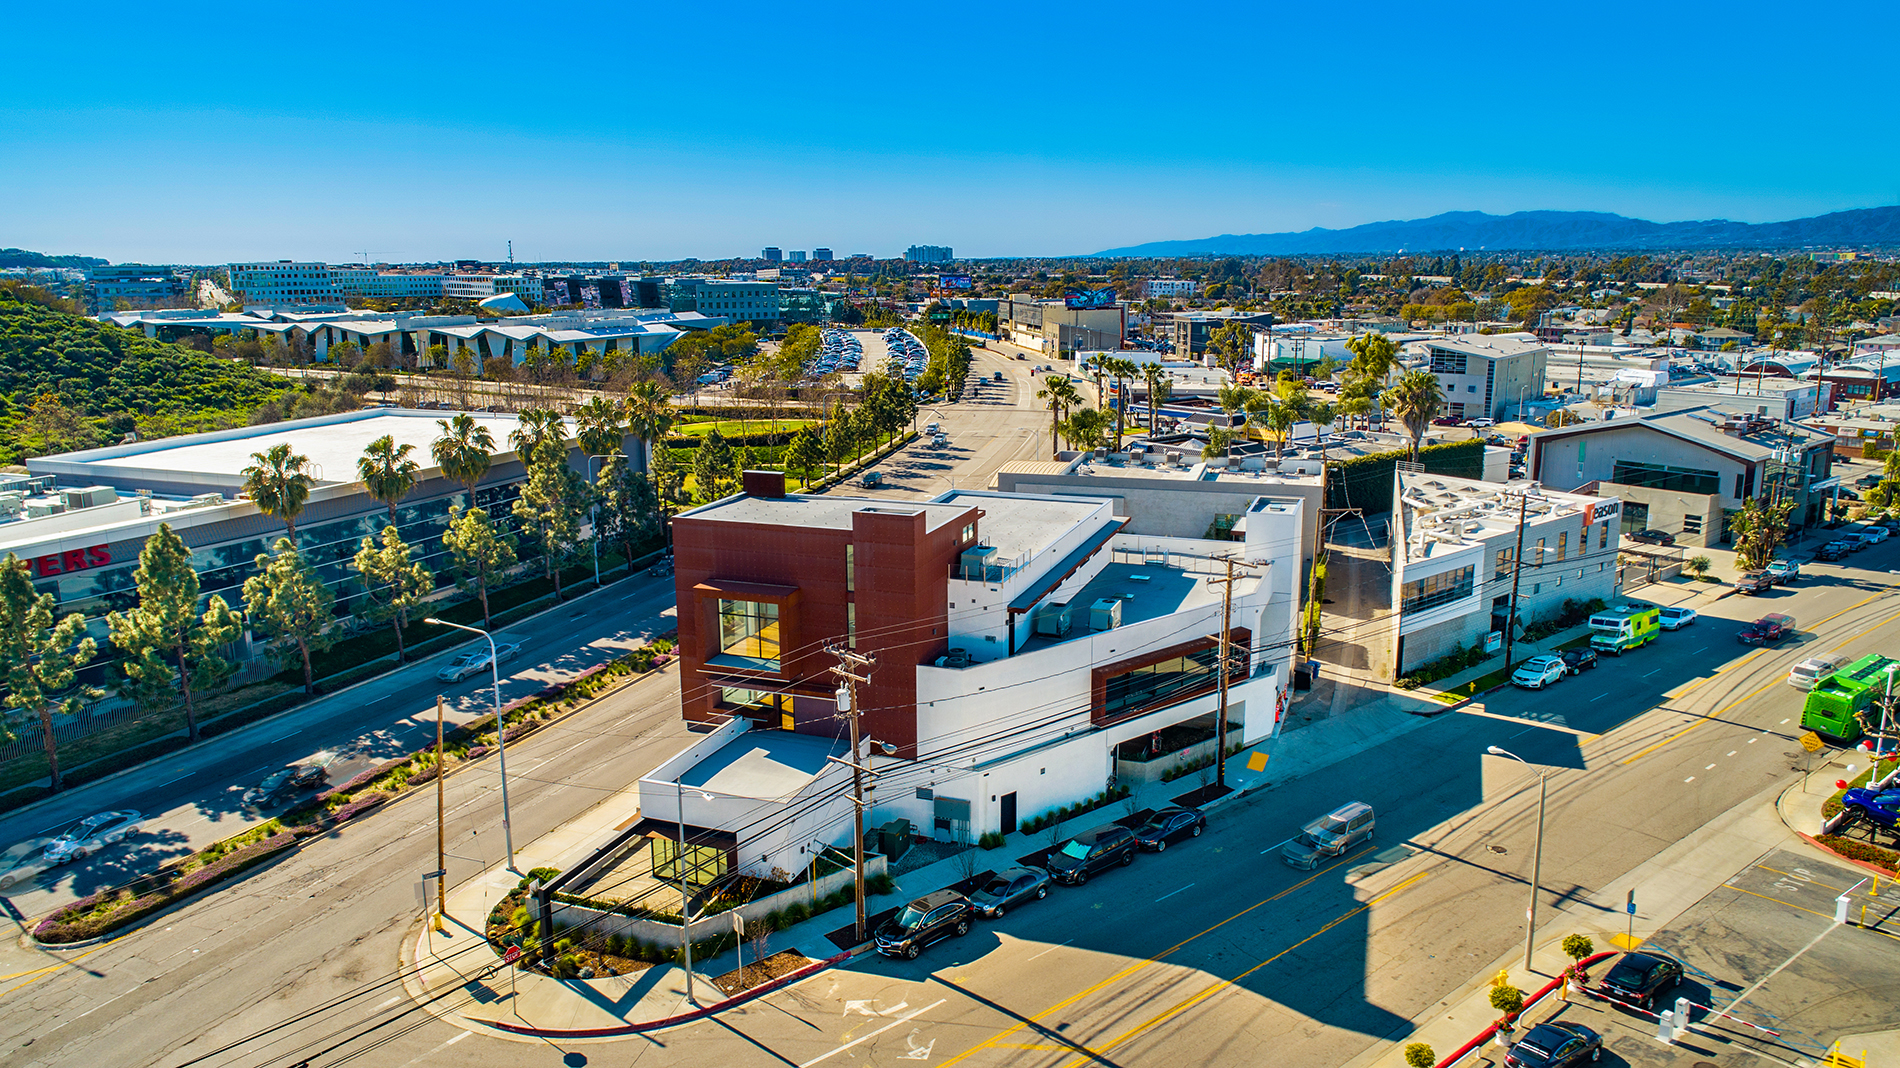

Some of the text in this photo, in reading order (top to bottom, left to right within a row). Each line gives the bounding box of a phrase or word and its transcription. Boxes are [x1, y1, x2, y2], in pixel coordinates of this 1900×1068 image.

[1590, 502, 1618, 520] reason
[1773, 867, 1816, 892] STOP
[505, 949, 521, 963] STOP
